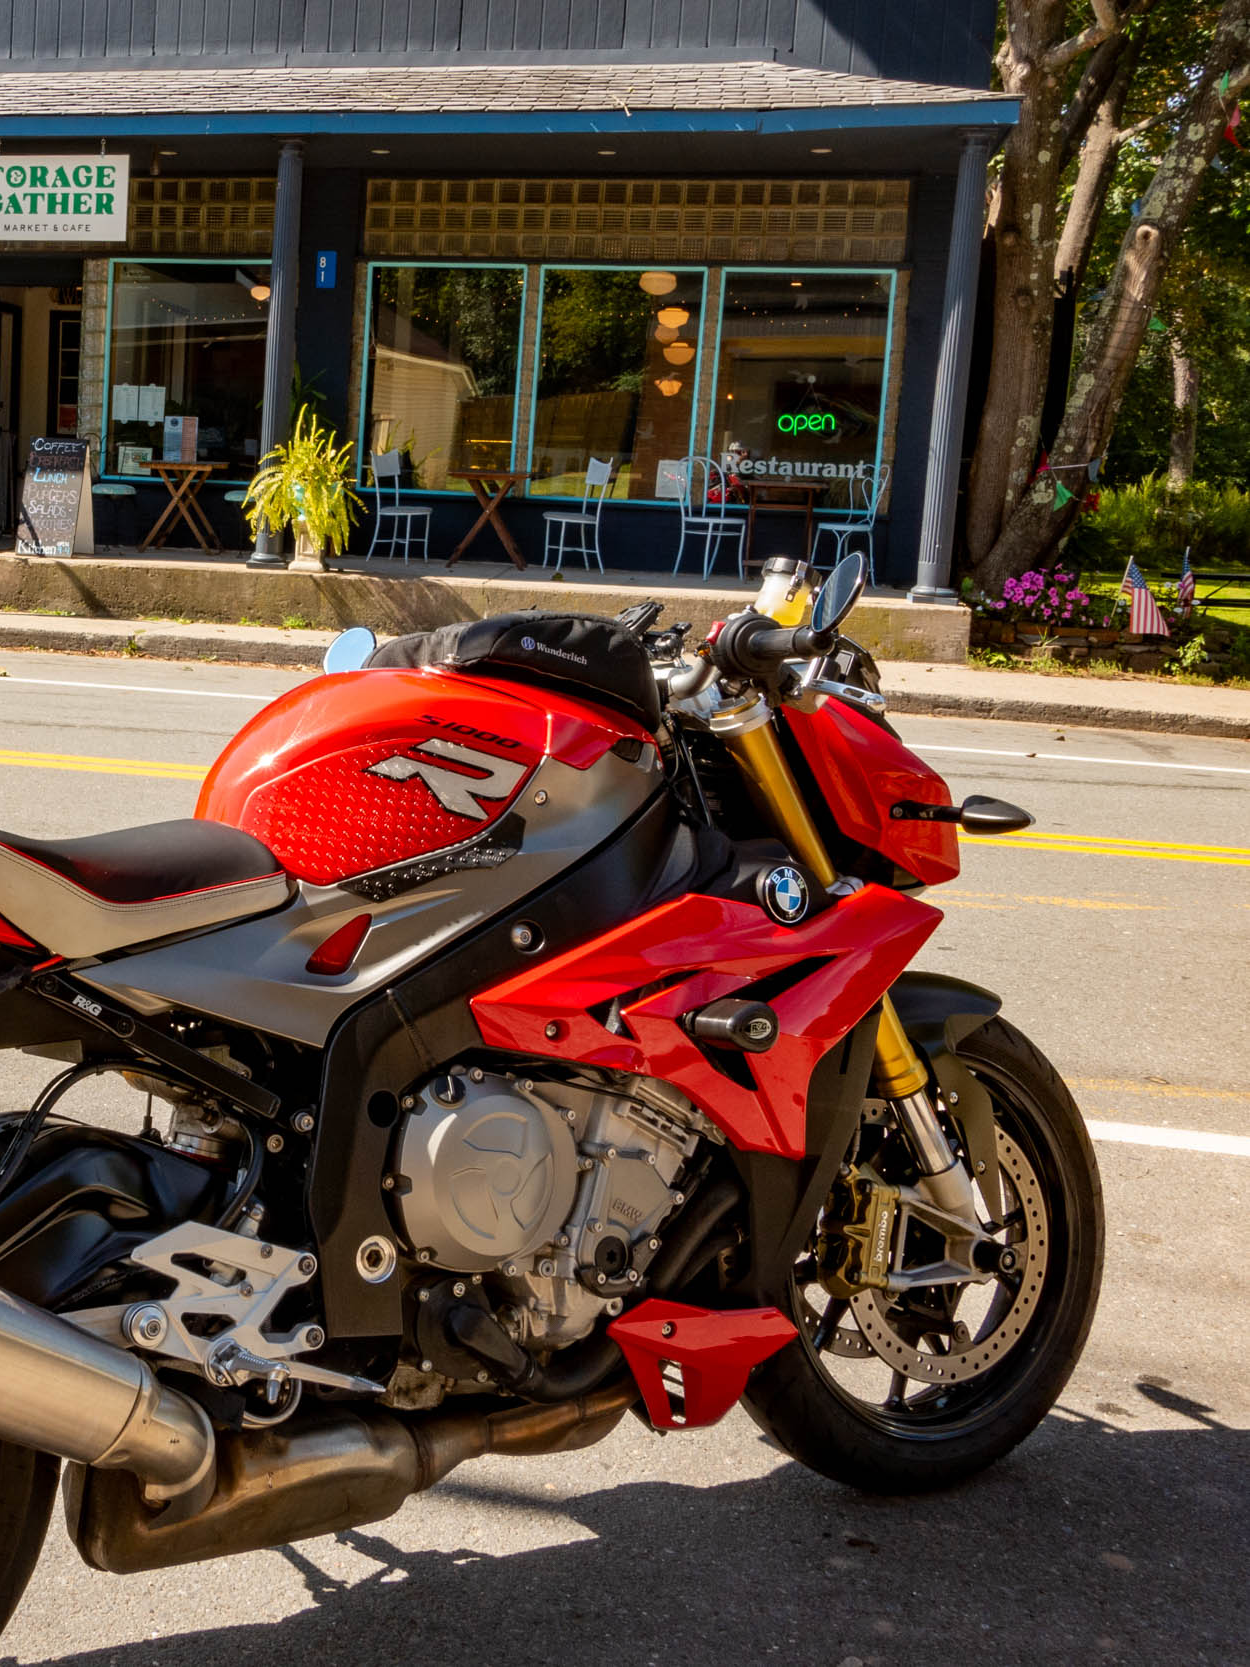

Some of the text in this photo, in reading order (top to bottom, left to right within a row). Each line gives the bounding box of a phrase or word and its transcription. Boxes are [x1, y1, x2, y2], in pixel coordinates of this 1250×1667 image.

[3, 224, 92, 232] MARKET & CAFE
[777, 414, 836, 437] open
[720, 452, 866, 479] Restaurant
[536, 642, 588, 666] Wunderlich
[414, 714, 521, 749] S1000
[771, 868, 805, 889] BMW
[72, 994, 102, 1017] R&G
[874, 1210, 888, 1262] brembo
